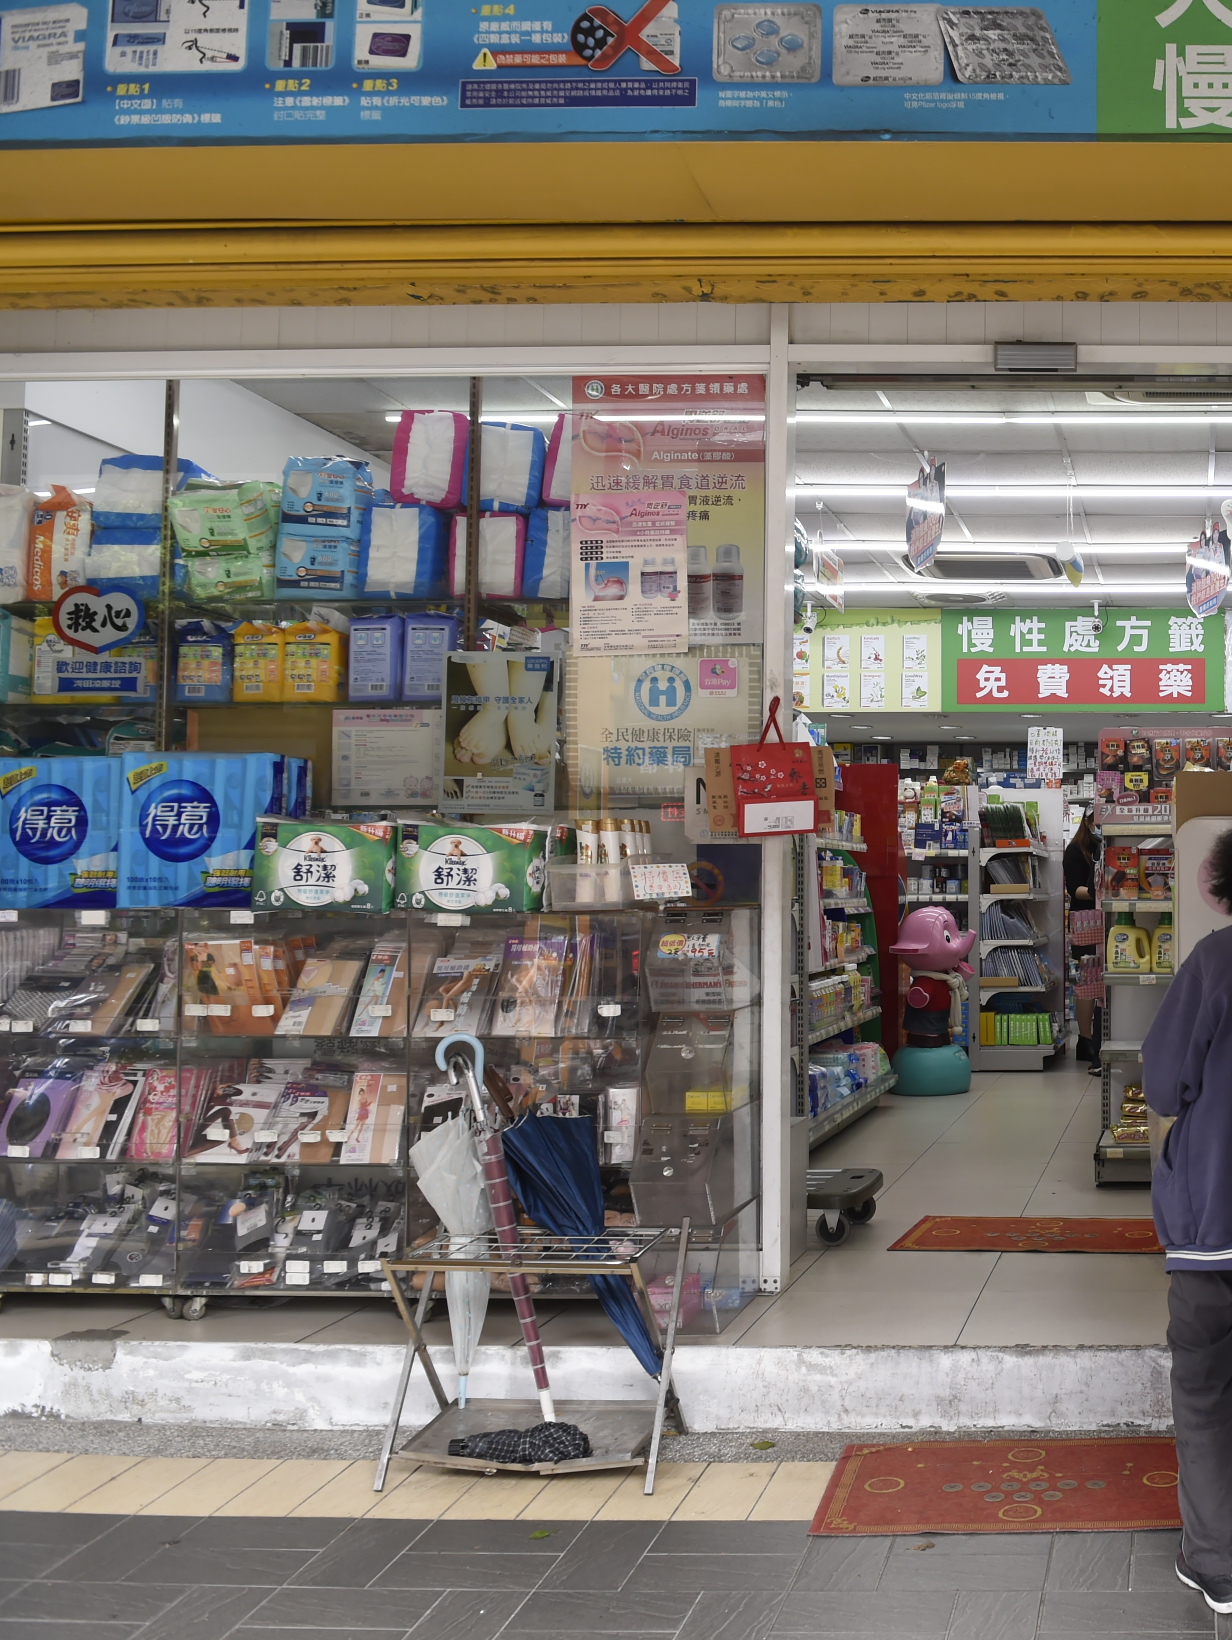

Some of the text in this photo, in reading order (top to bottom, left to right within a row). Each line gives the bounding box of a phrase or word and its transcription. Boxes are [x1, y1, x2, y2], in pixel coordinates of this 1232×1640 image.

[12, 31, 68, 44] VIAGRA
[116, 83, 150, 95] 重點1
[274, 79, 311, 92] 重點2
[362, 79, 399, 91] 重點3
[611, 382, 749, 395] 各大醫院處方箋領藥處
[650, 420, 709, 438] Alginos
[590, 474, 746, 491] 迅速緩解胃食道逆流
[687, 510, 710, 522] 疼痛
[32, 535, 45, 591] Medicos
[65, 602, 132, 634] 救心
[957, 614, 1206, 654] 慢性處方籤
[56, 660, 142, 675] 歡迎健康諮詢
[975, 662, 1194, 699] 免費領藥
[650, 714, 672, 722] HEALTH
[671, 692, 692, 720] INSURANCE
[600, 727, 692, 743] 全民健康保險
[602, 745, 692, 767] 特約藥局
[13, 804, 80, 843] 得意
[142, 801, 212, 840] 得意
[292, 862, 337, 884] 舒潔
[433, 865, 478, 888] 舒潔
[660, 939, 684, 947] 超低價
